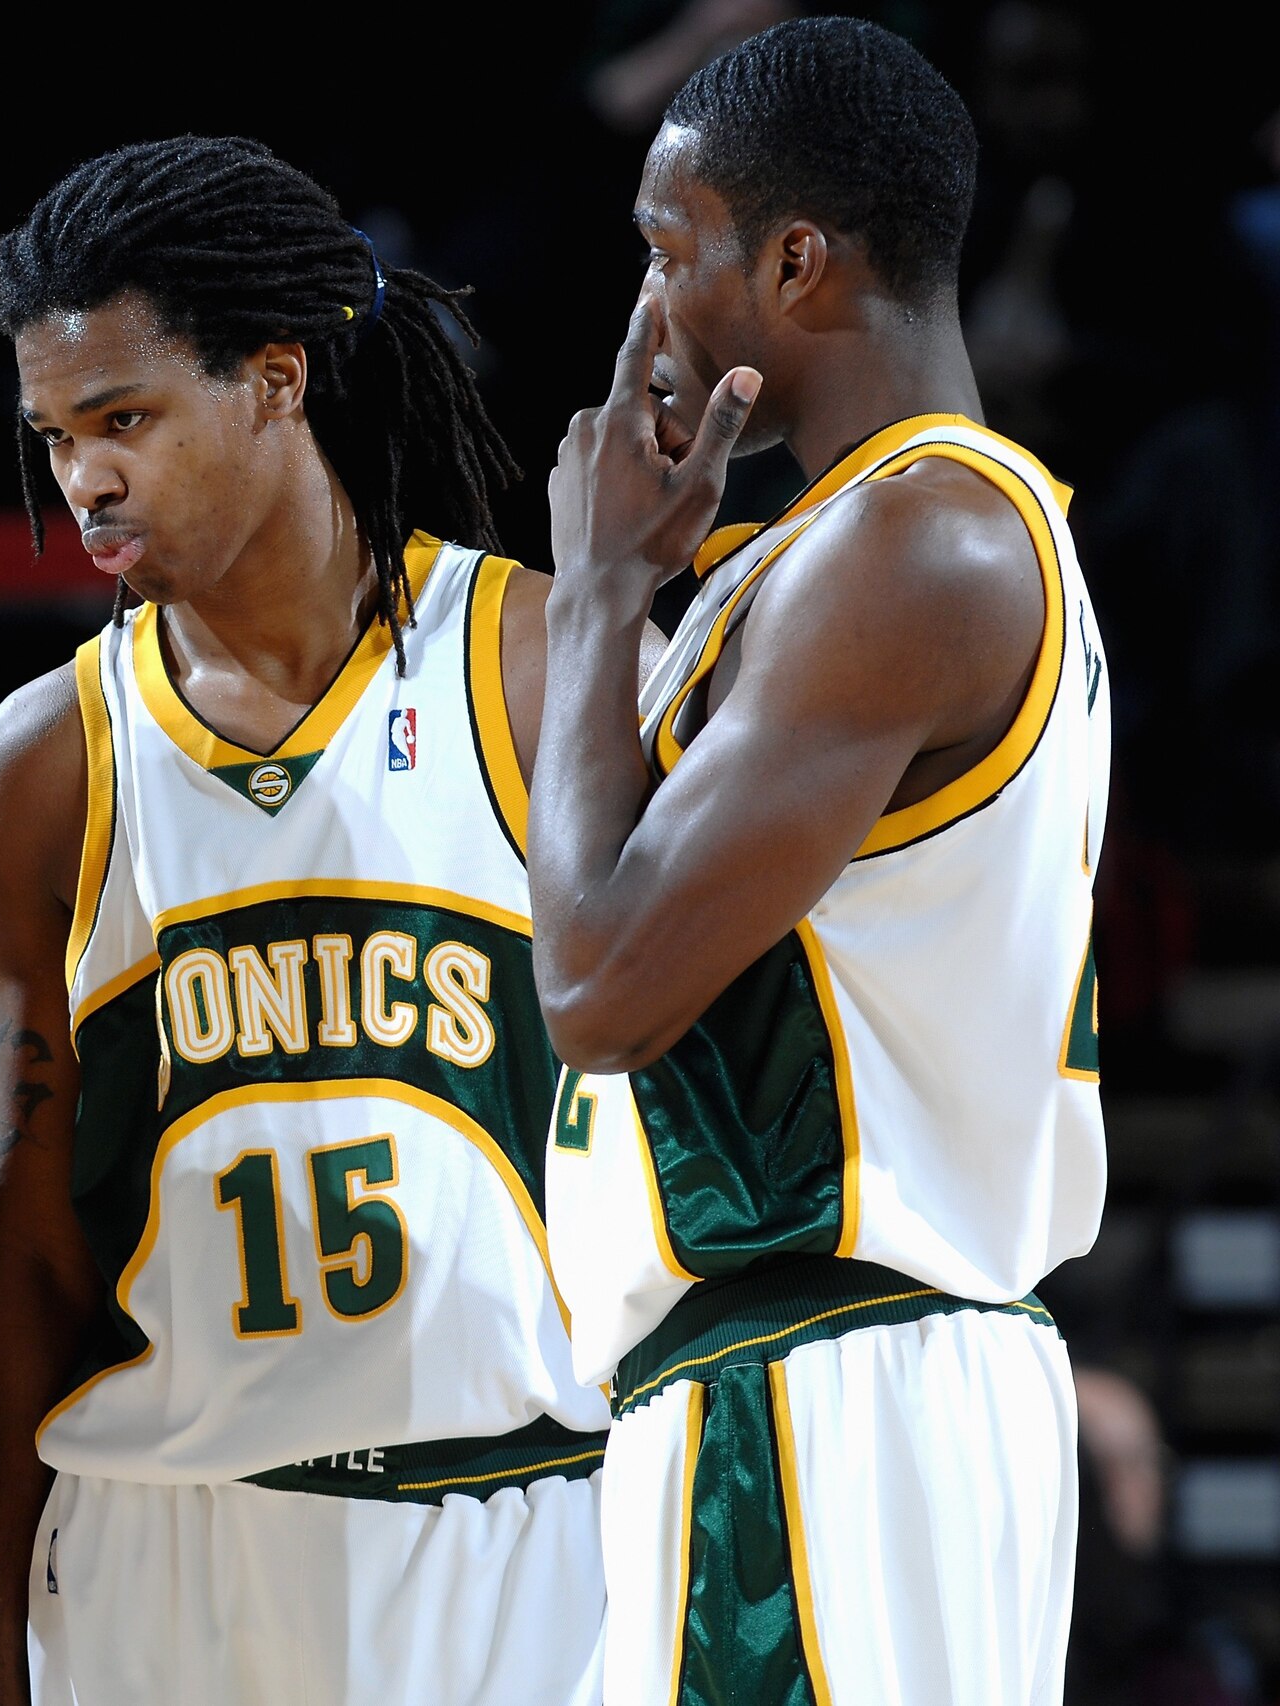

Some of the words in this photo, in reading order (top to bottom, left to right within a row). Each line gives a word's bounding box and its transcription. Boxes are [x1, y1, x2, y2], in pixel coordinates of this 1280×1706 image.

[391, 758, 407, 769] NBA
[156, 931, 496, 1112] ONICS
[214, 1132, 410, 1340] 15
